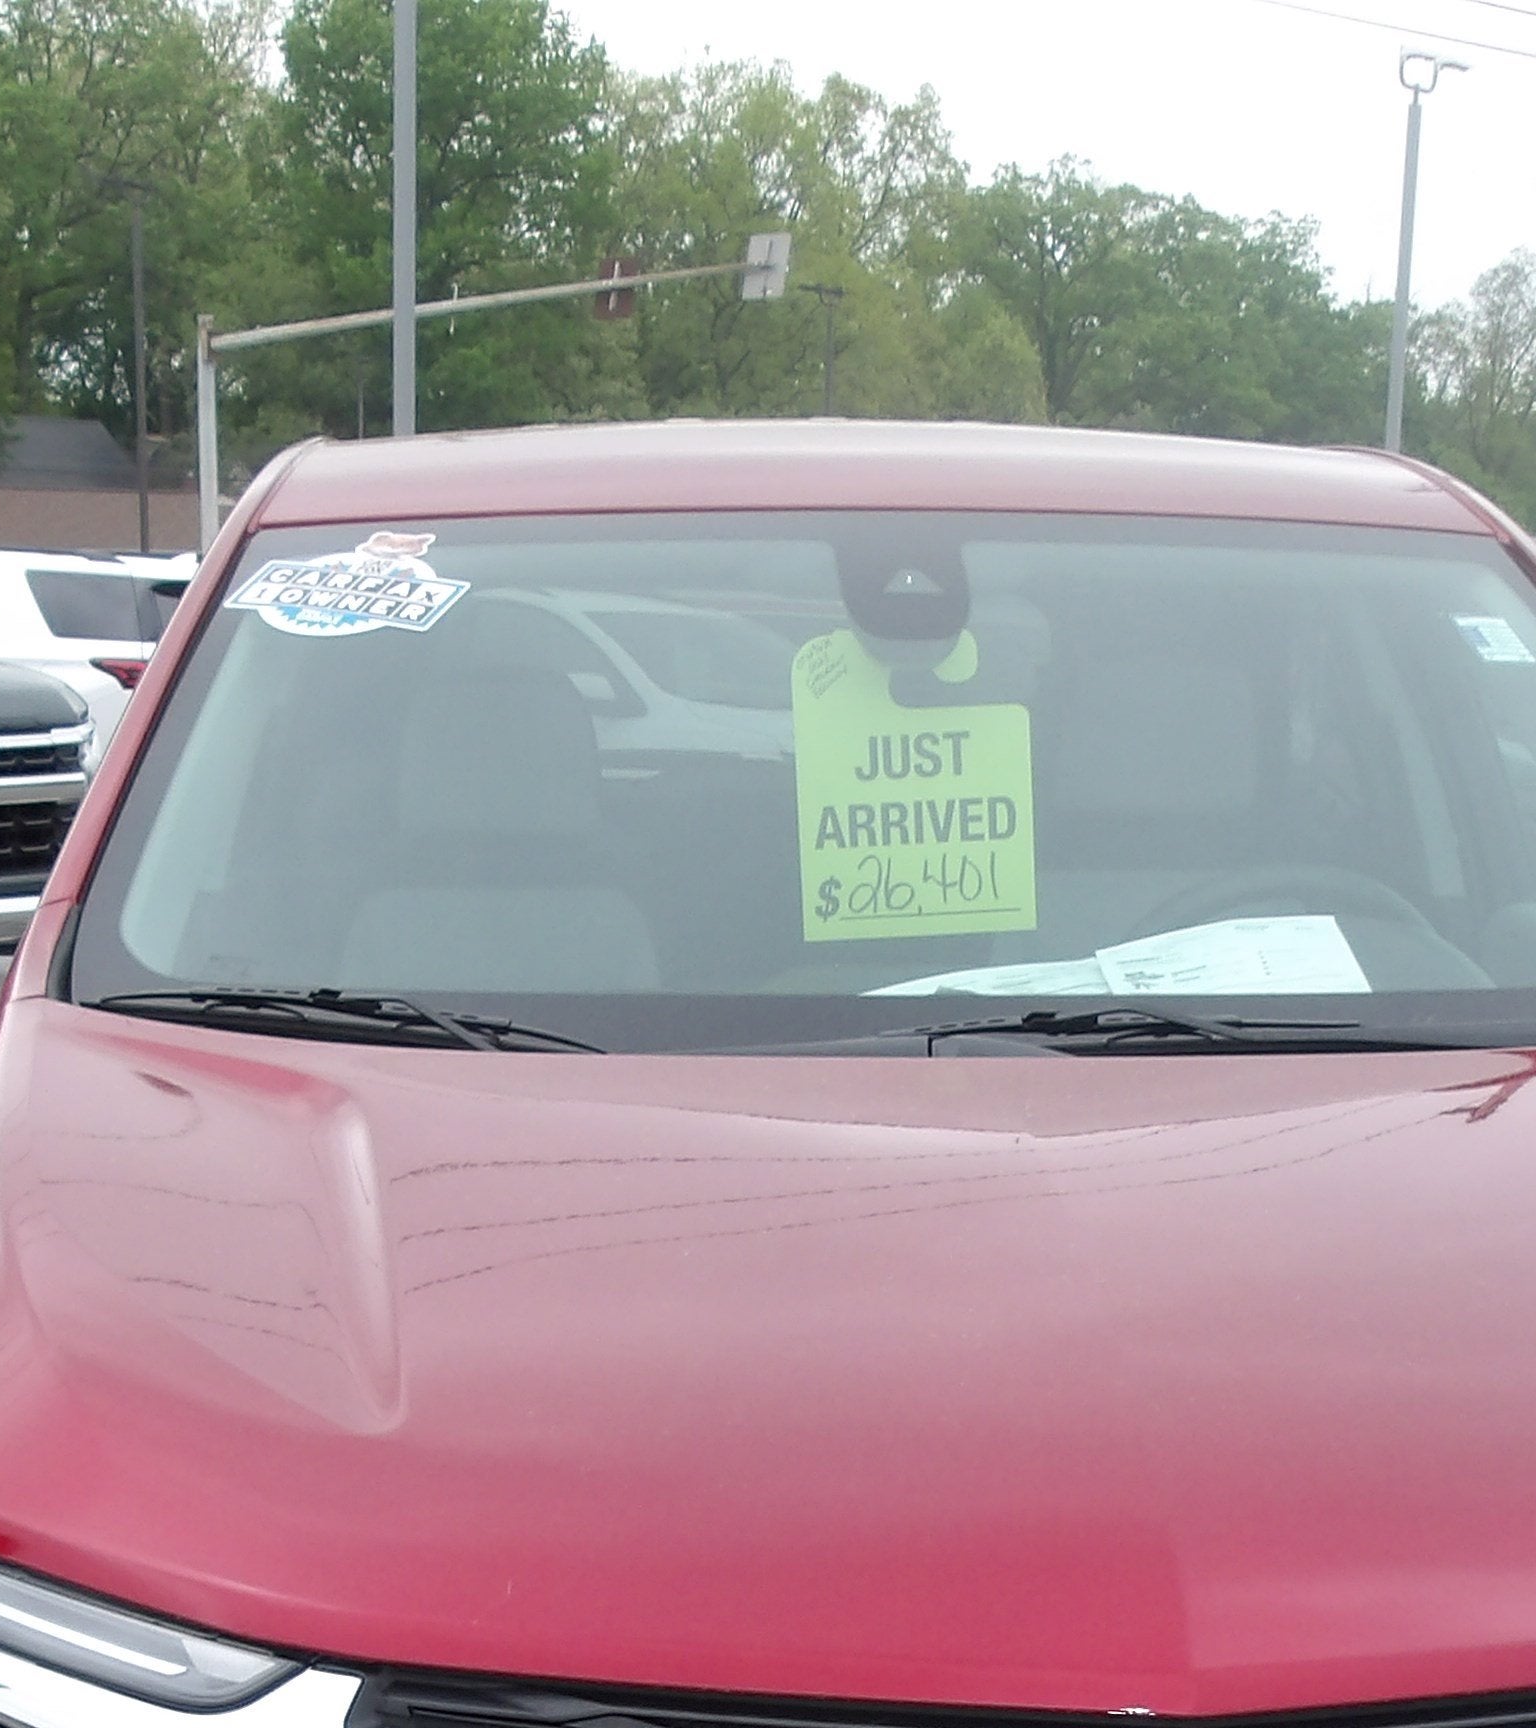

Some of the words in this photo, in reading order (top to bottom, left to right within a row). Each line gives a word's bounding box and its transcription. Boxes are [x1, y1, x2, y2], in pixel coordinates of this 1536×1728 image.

[268, 567, 439, 604] CARFAX
[278, 588, 428, 621] OWNER
[854, 730, 971, 781] JUST
[814, 796, 1018, 850] ARRIVED
